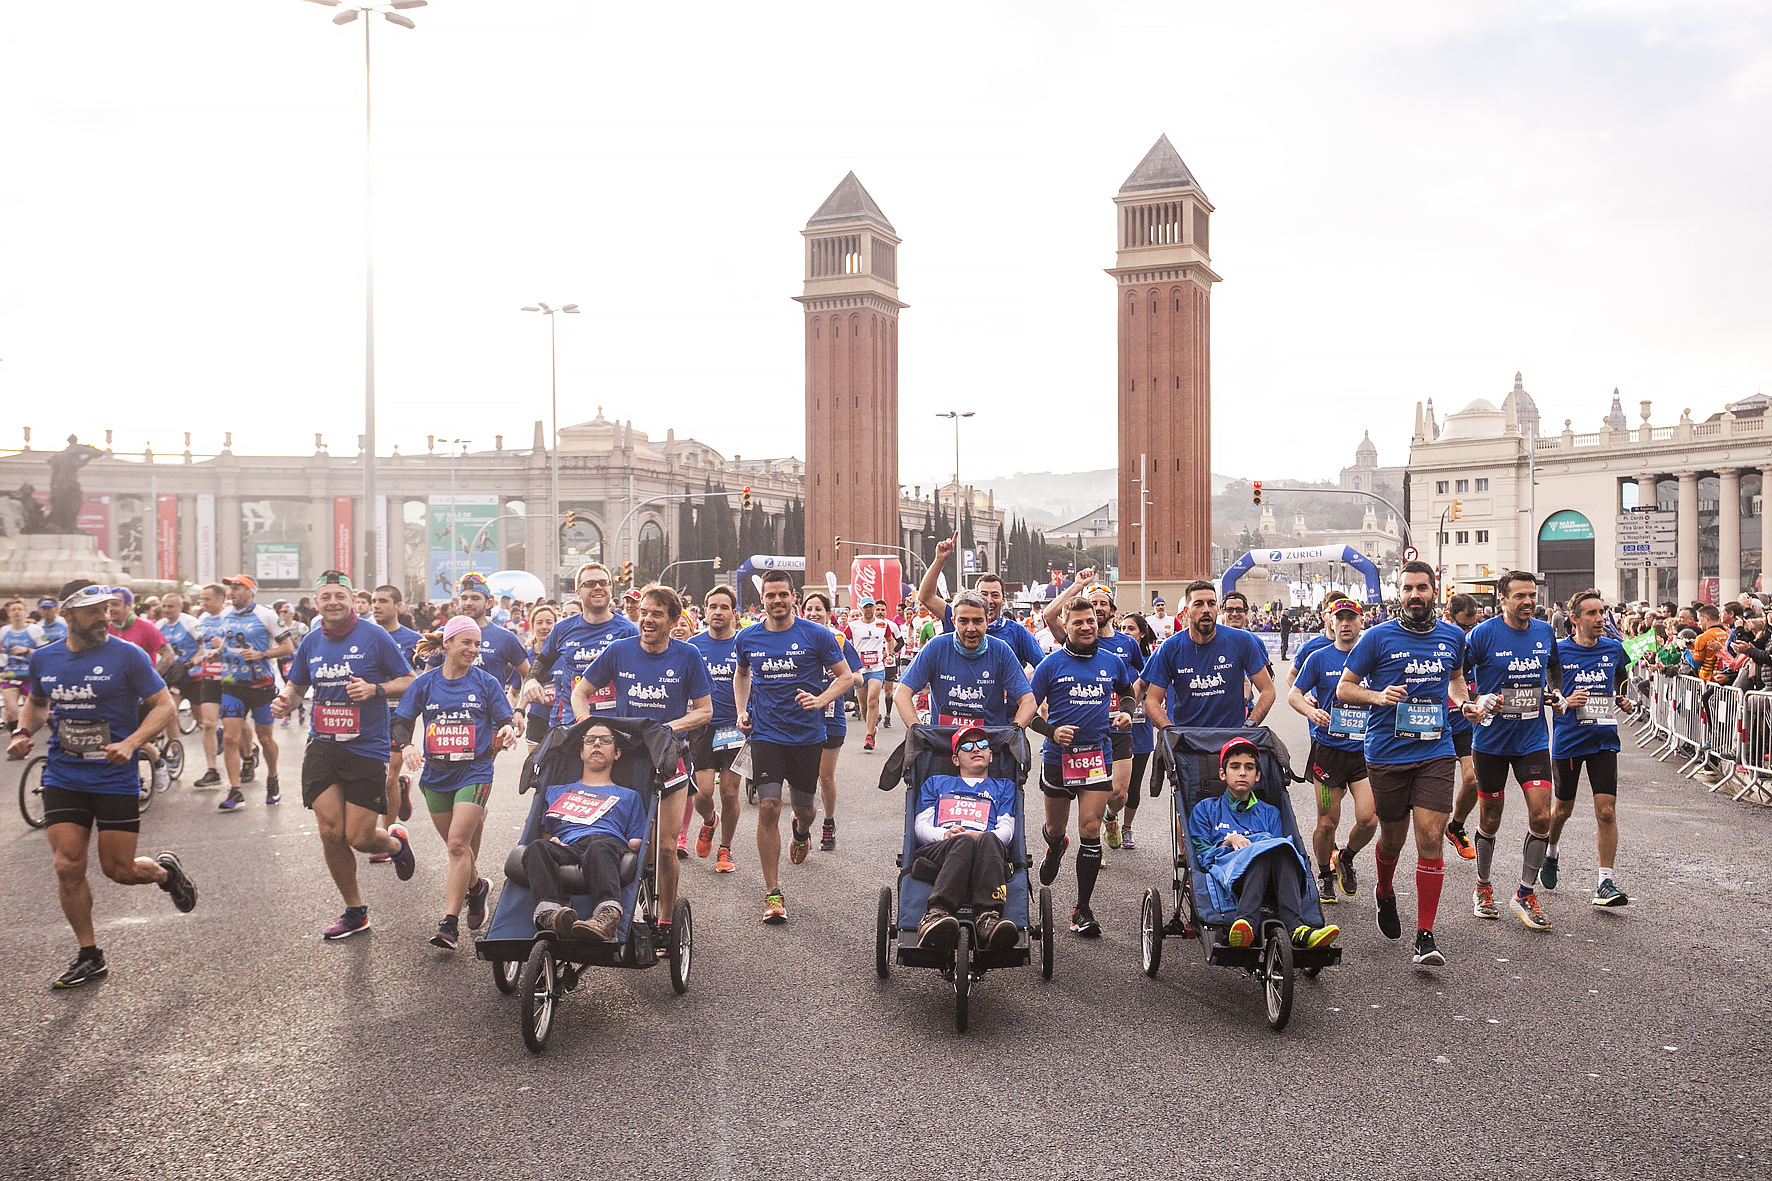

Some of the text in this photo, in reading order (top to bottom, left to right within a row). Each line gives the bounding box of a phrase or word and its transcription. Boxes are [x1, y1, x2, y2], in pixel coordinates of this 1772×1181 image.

[1286, 550, 1322, 559] ZURICH
[595, 687, 611, 696] 165
[1515, 689, 1533, 698] JAVI
[629, 700, 666, 709] #imparables
[949, 700, 983, 708] #imparables
[1510, 698, 1536, 706] 15723
[1340, 709, 1366, 719] VÍCTOR
[322, 718, 354, 727] 18170
[952, 718, 975, 726] ALEX
[1340, 719, 1364, 728] 3628
[1410, 715, 1436, 725] 3224
[436, 724, 470, 735] MARÍA
[66, 734, 103, 745] 15729
[717, 731, 738, 740] 3685
[436, 736, 469, 746] 18168
[1068, 756, 1102, 768] 16845
[562, 801, 592, 814] 18174
[949, 808, 982, 818] 18176
